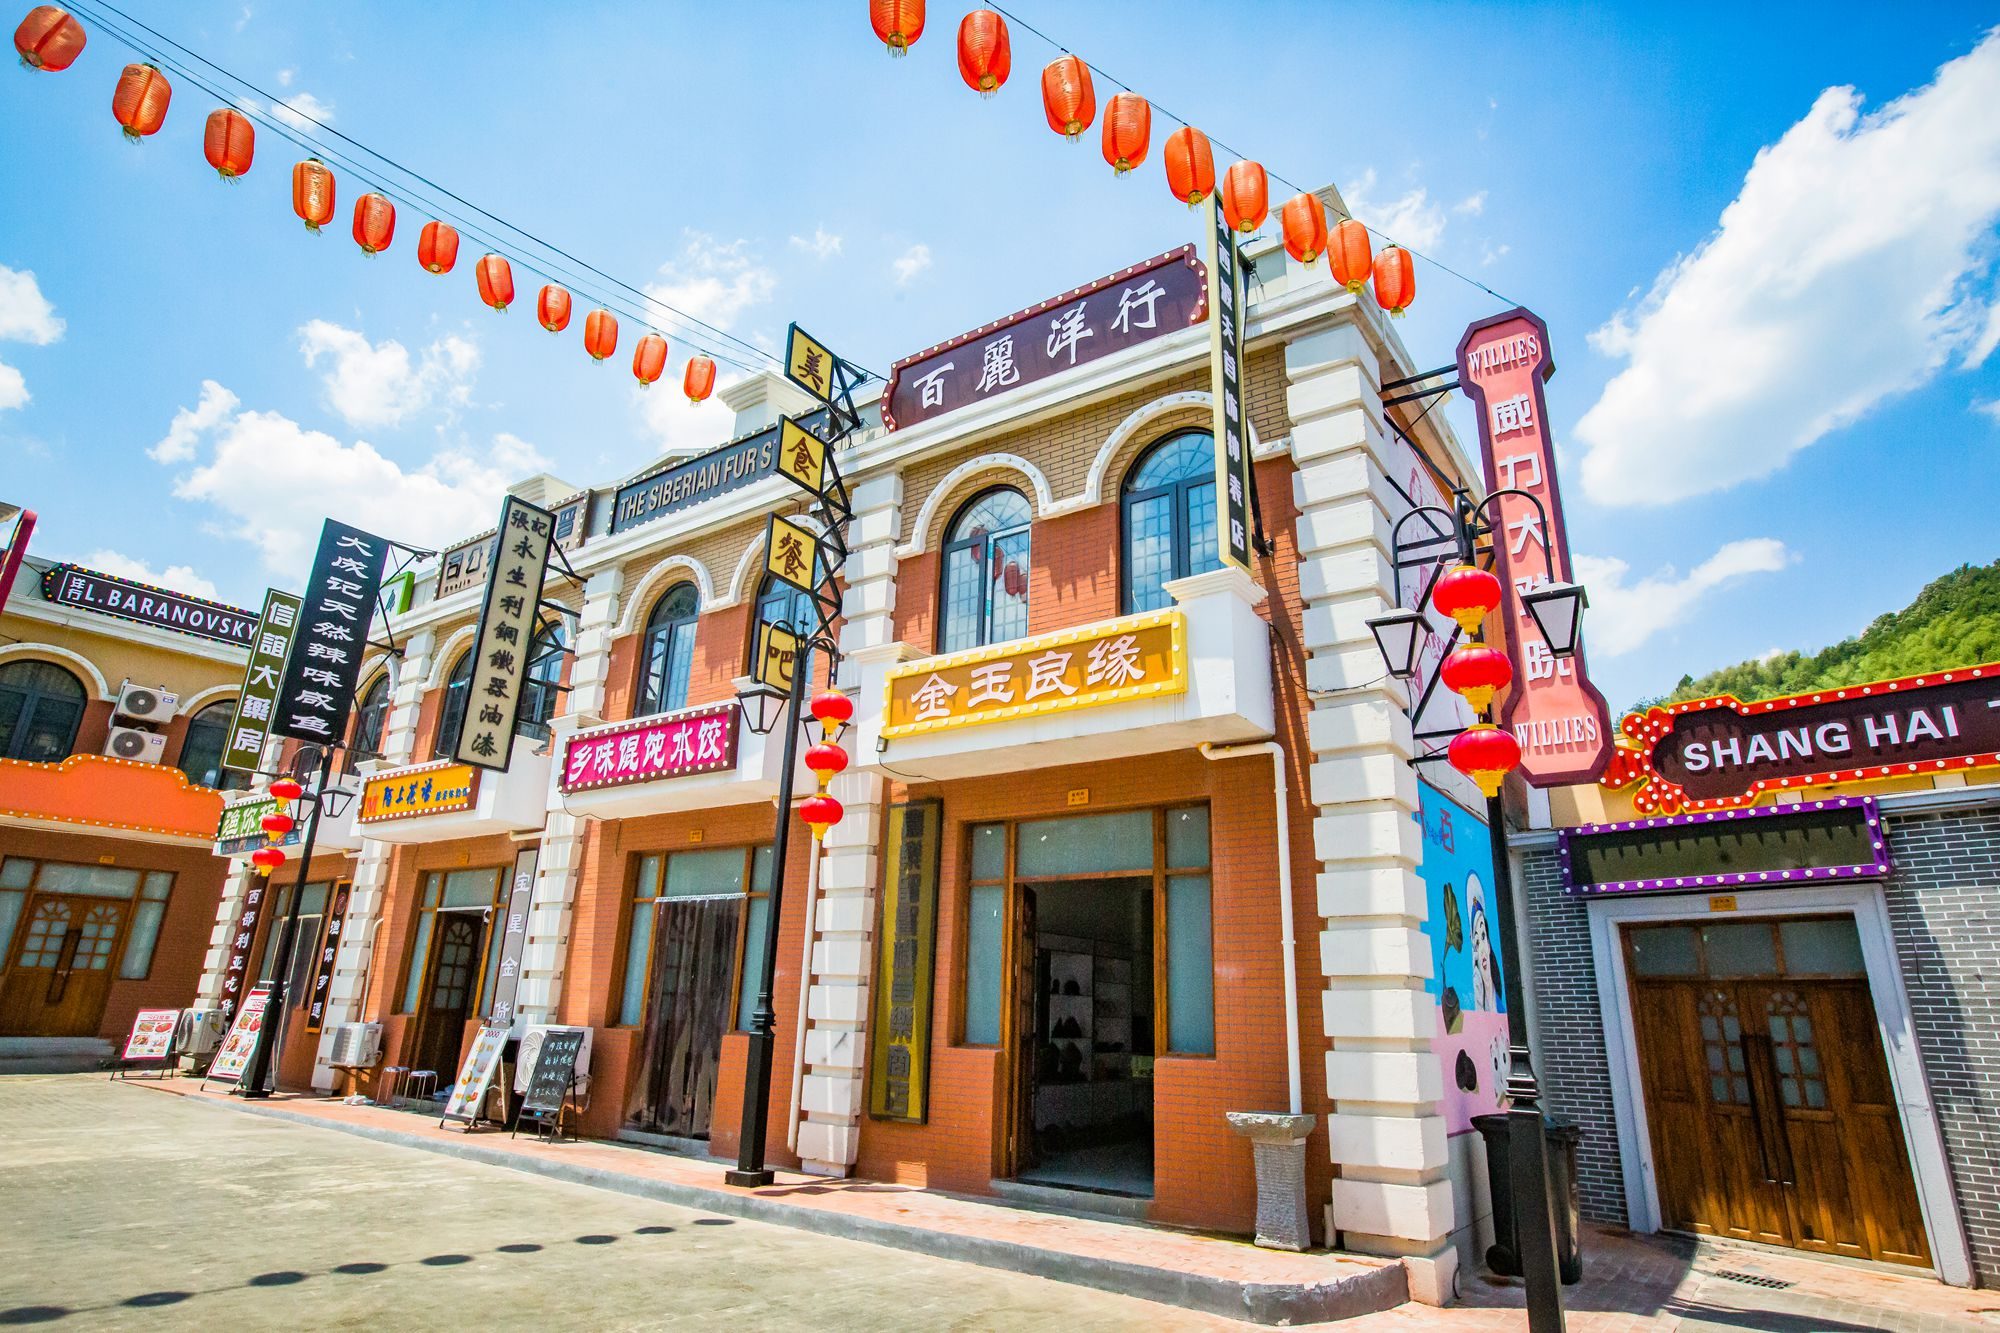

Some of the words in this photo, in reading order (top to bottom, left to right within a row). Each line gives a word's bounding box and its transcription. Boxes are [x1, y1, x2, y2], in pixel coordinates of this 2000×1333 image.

[797, 347, 824, 392] 美
[913, 279, 1166, 410] 百麗洋行
[1467, 335, 1538, 371] WILLIES
[620, 490, 648, 523] THE
[649, 458, 721, 512] SIBERIAN
[723, 445, 760, 485] FUR
[786, 436, 818, 481] 食
[775, 532, 808, 580] 餐
[67, 576, 87, 601] 洋行
[232, 601, 295, 753] 信誼大藥房
[911, 634, 1146, 722] 金玉良缘
[568, 719, 722, 783] 乡味馄饨水饺
[1515, 715, 1597, 748] WILLIES
[1684, 722, 1851, 771] SHANG
[1863, 706, 1960, 748] HAI
